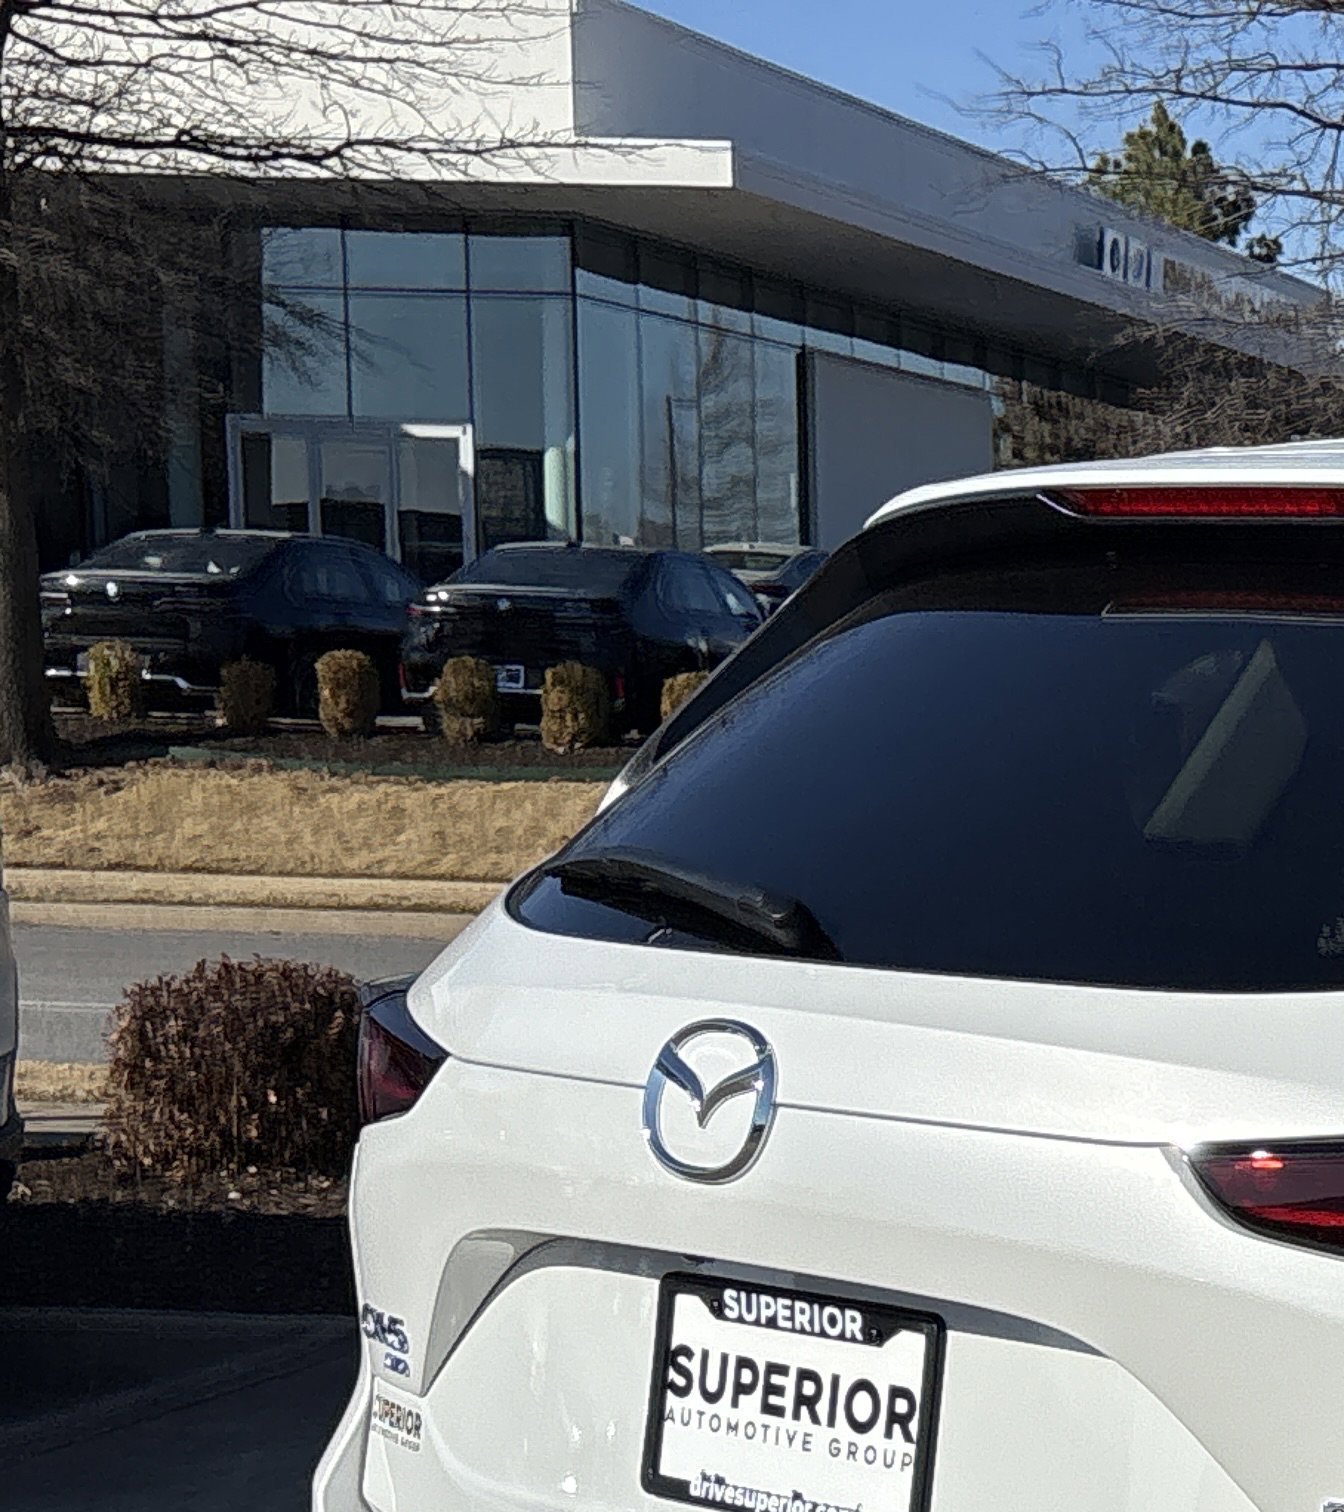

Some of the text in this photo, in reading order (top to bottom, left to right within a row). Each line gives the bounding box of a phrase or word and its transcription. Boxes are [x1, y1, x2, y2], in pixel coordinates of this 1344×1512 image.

[722, 1288, 863, 1341] SUPERIOR
[666, 1343, 918, 1445] SUPERIOR
[663, 1405, 914, 1473] AUTOMOTIVE GROUP
